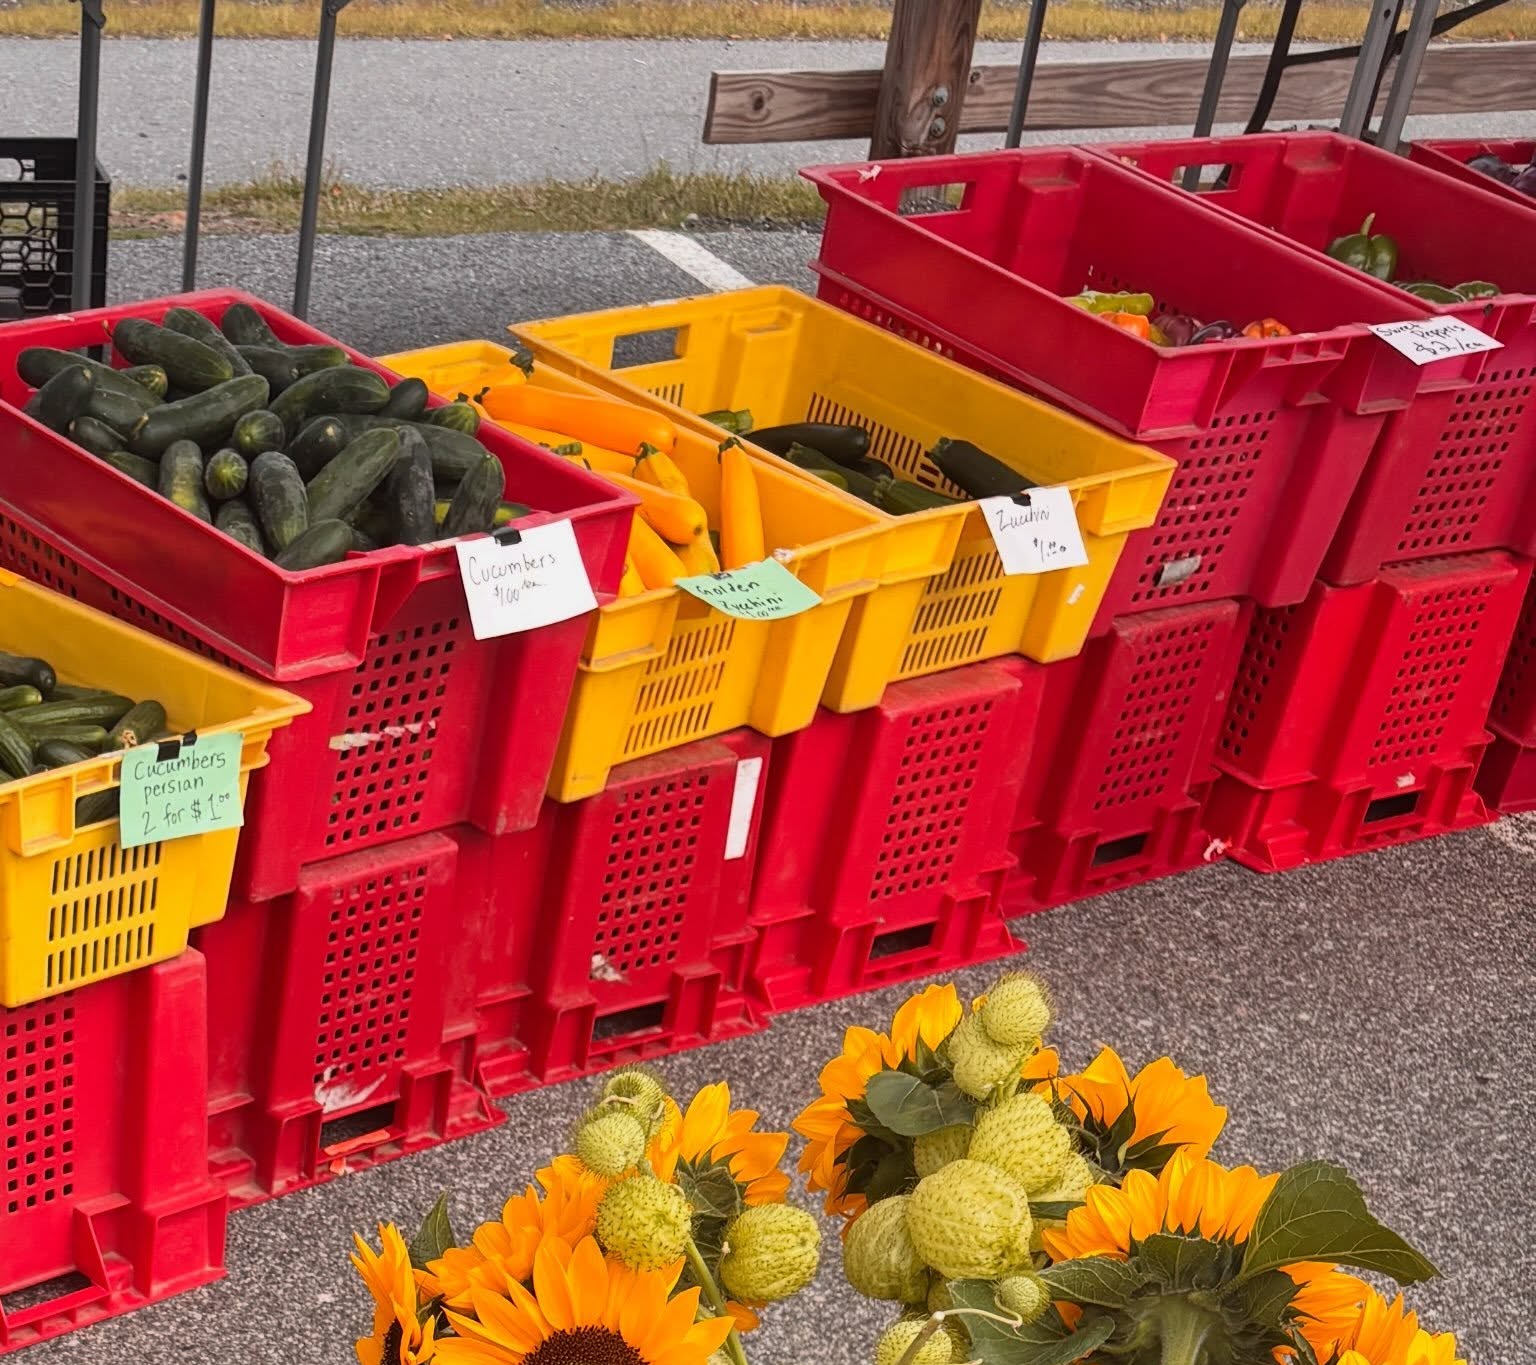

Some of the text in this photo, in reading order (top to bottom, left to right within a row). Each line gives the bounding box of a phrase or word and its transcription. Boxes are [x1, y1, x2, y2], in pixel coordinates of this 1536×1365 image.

[134, 750, 226, 780] Cucumbers
[144, 776, 204, 805] persian
[142, 811, 157, 836] 2
[163, 802, 185, 827] for
